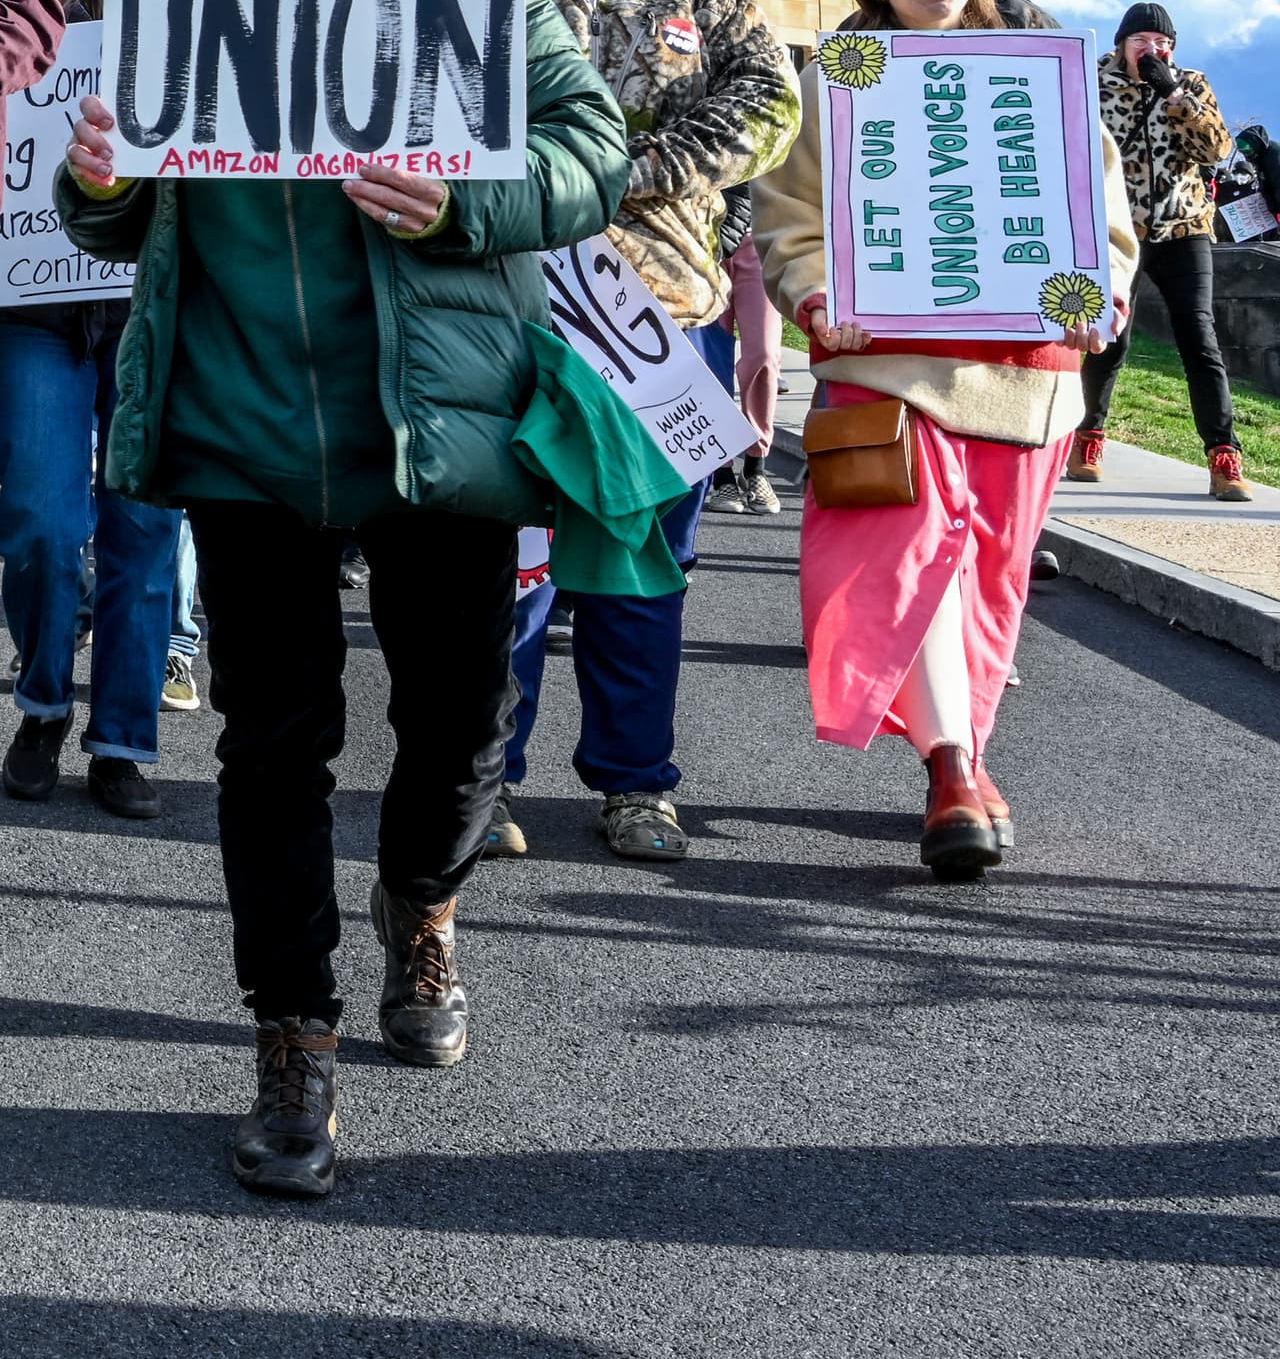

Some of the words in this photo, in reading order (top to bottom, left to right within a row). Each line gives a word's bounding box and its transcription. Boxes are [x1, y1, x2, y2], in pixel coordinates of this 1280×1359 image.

[923, 61, 969, 177] VOICES
[989, 76, 1040, 197] HEARD!
[157, 148, 280, 177] AMAZON
[297, 150, 471, 177] ORGANIZERS!
[861, 120, 897, 179] OUR
[863, 200, 904, 271] LET
[929, 185, 980, 306] UNION
[1004, 217, 1050, 264] BE
[656, 397, 703, 434] www.
[665, 415, 716, 455] cpusa.
[688, 432, 728, 462] org
